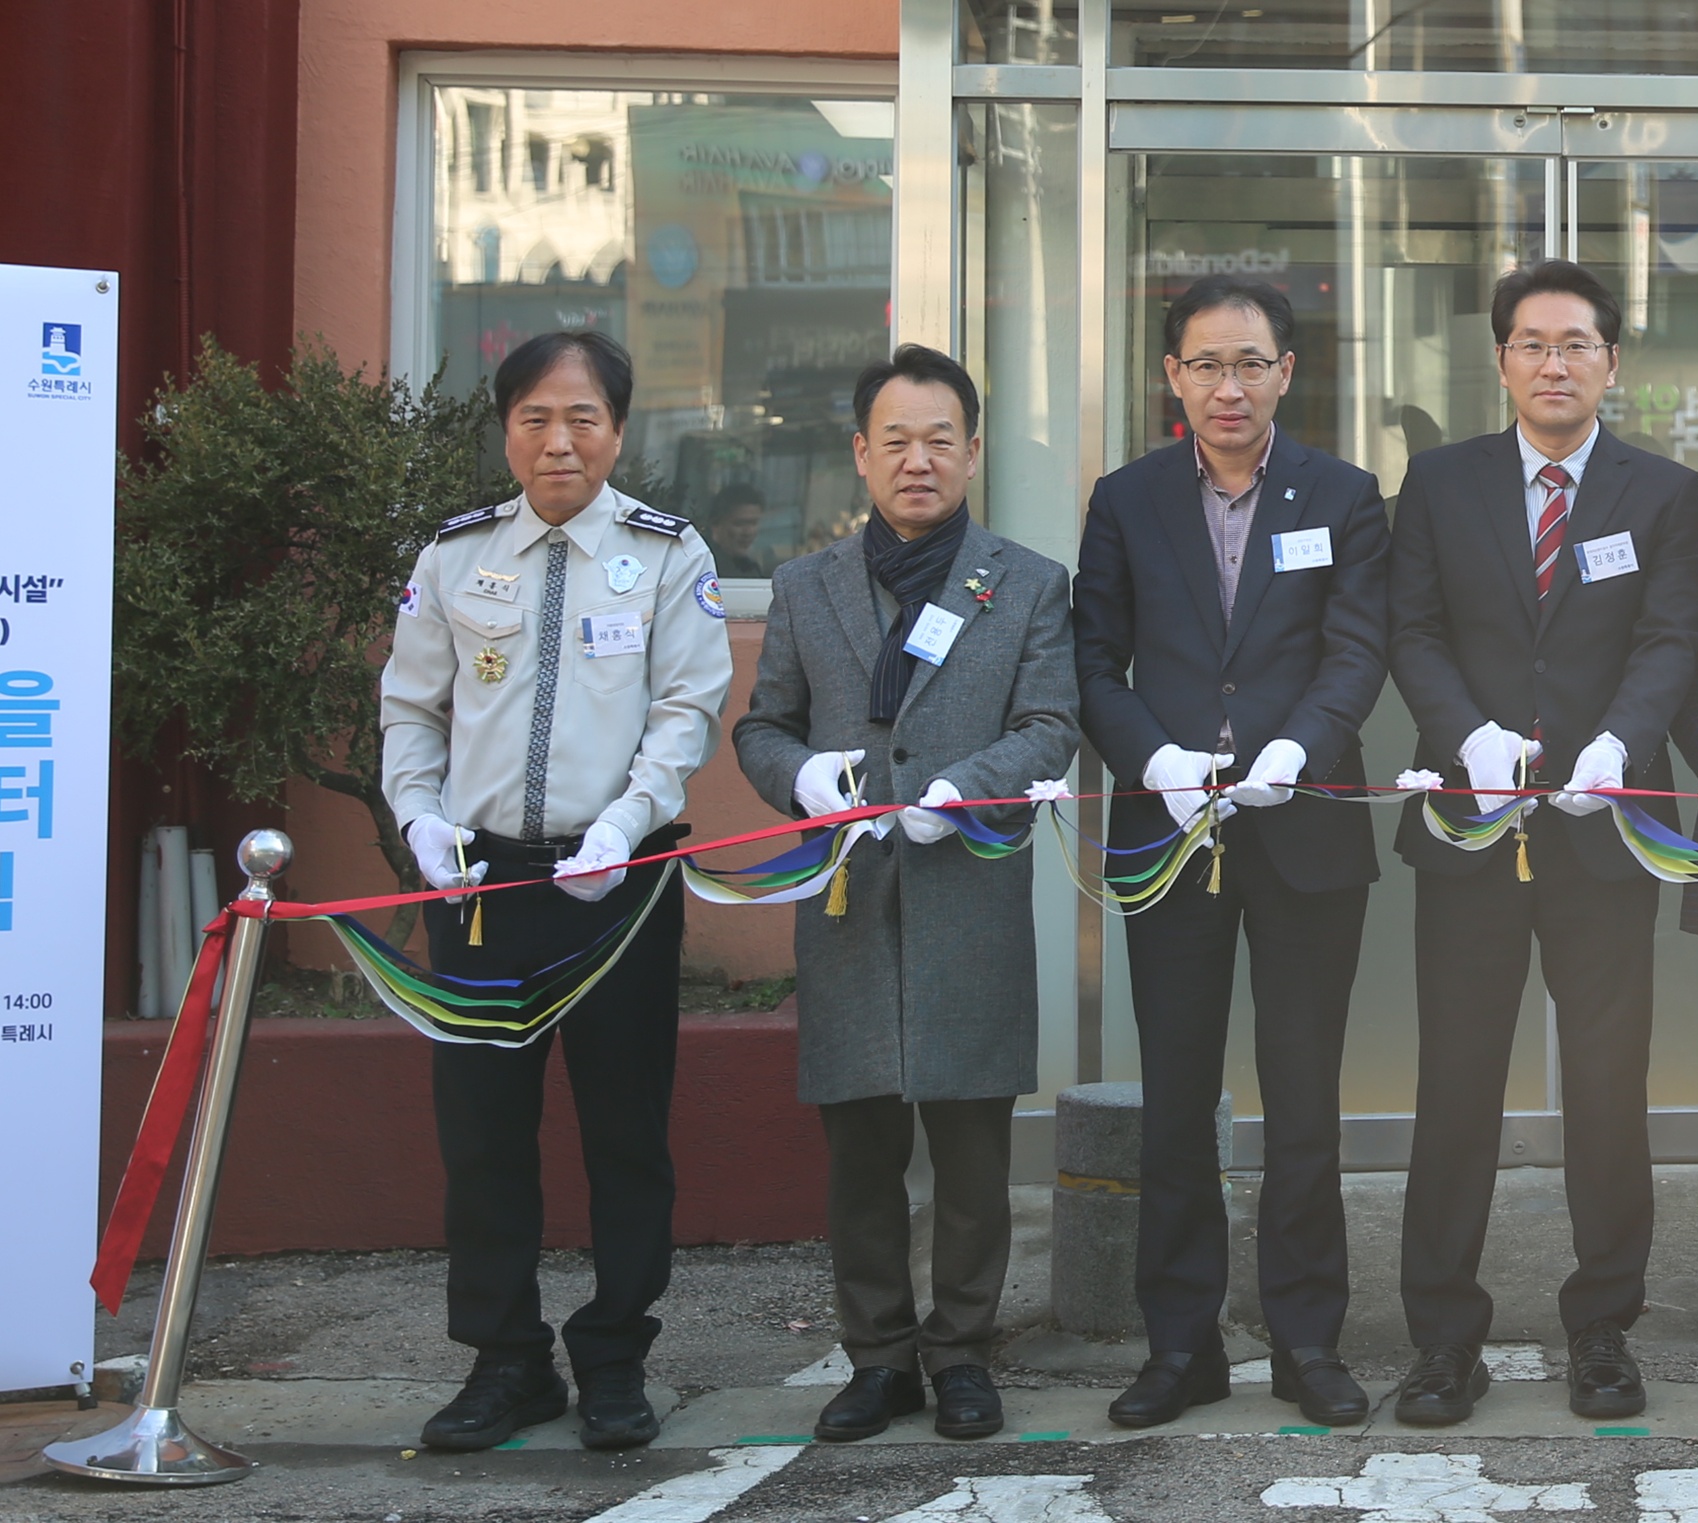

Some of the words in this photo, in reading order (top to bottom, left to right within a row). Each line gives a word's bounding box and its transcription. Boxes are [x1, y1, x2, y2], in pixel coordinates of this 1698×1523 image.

[27, 378, 92, 395] 수원특례시
[4, 993, 52, 1010] 14:00
[1, 1023, 53, 1043] 특례시
